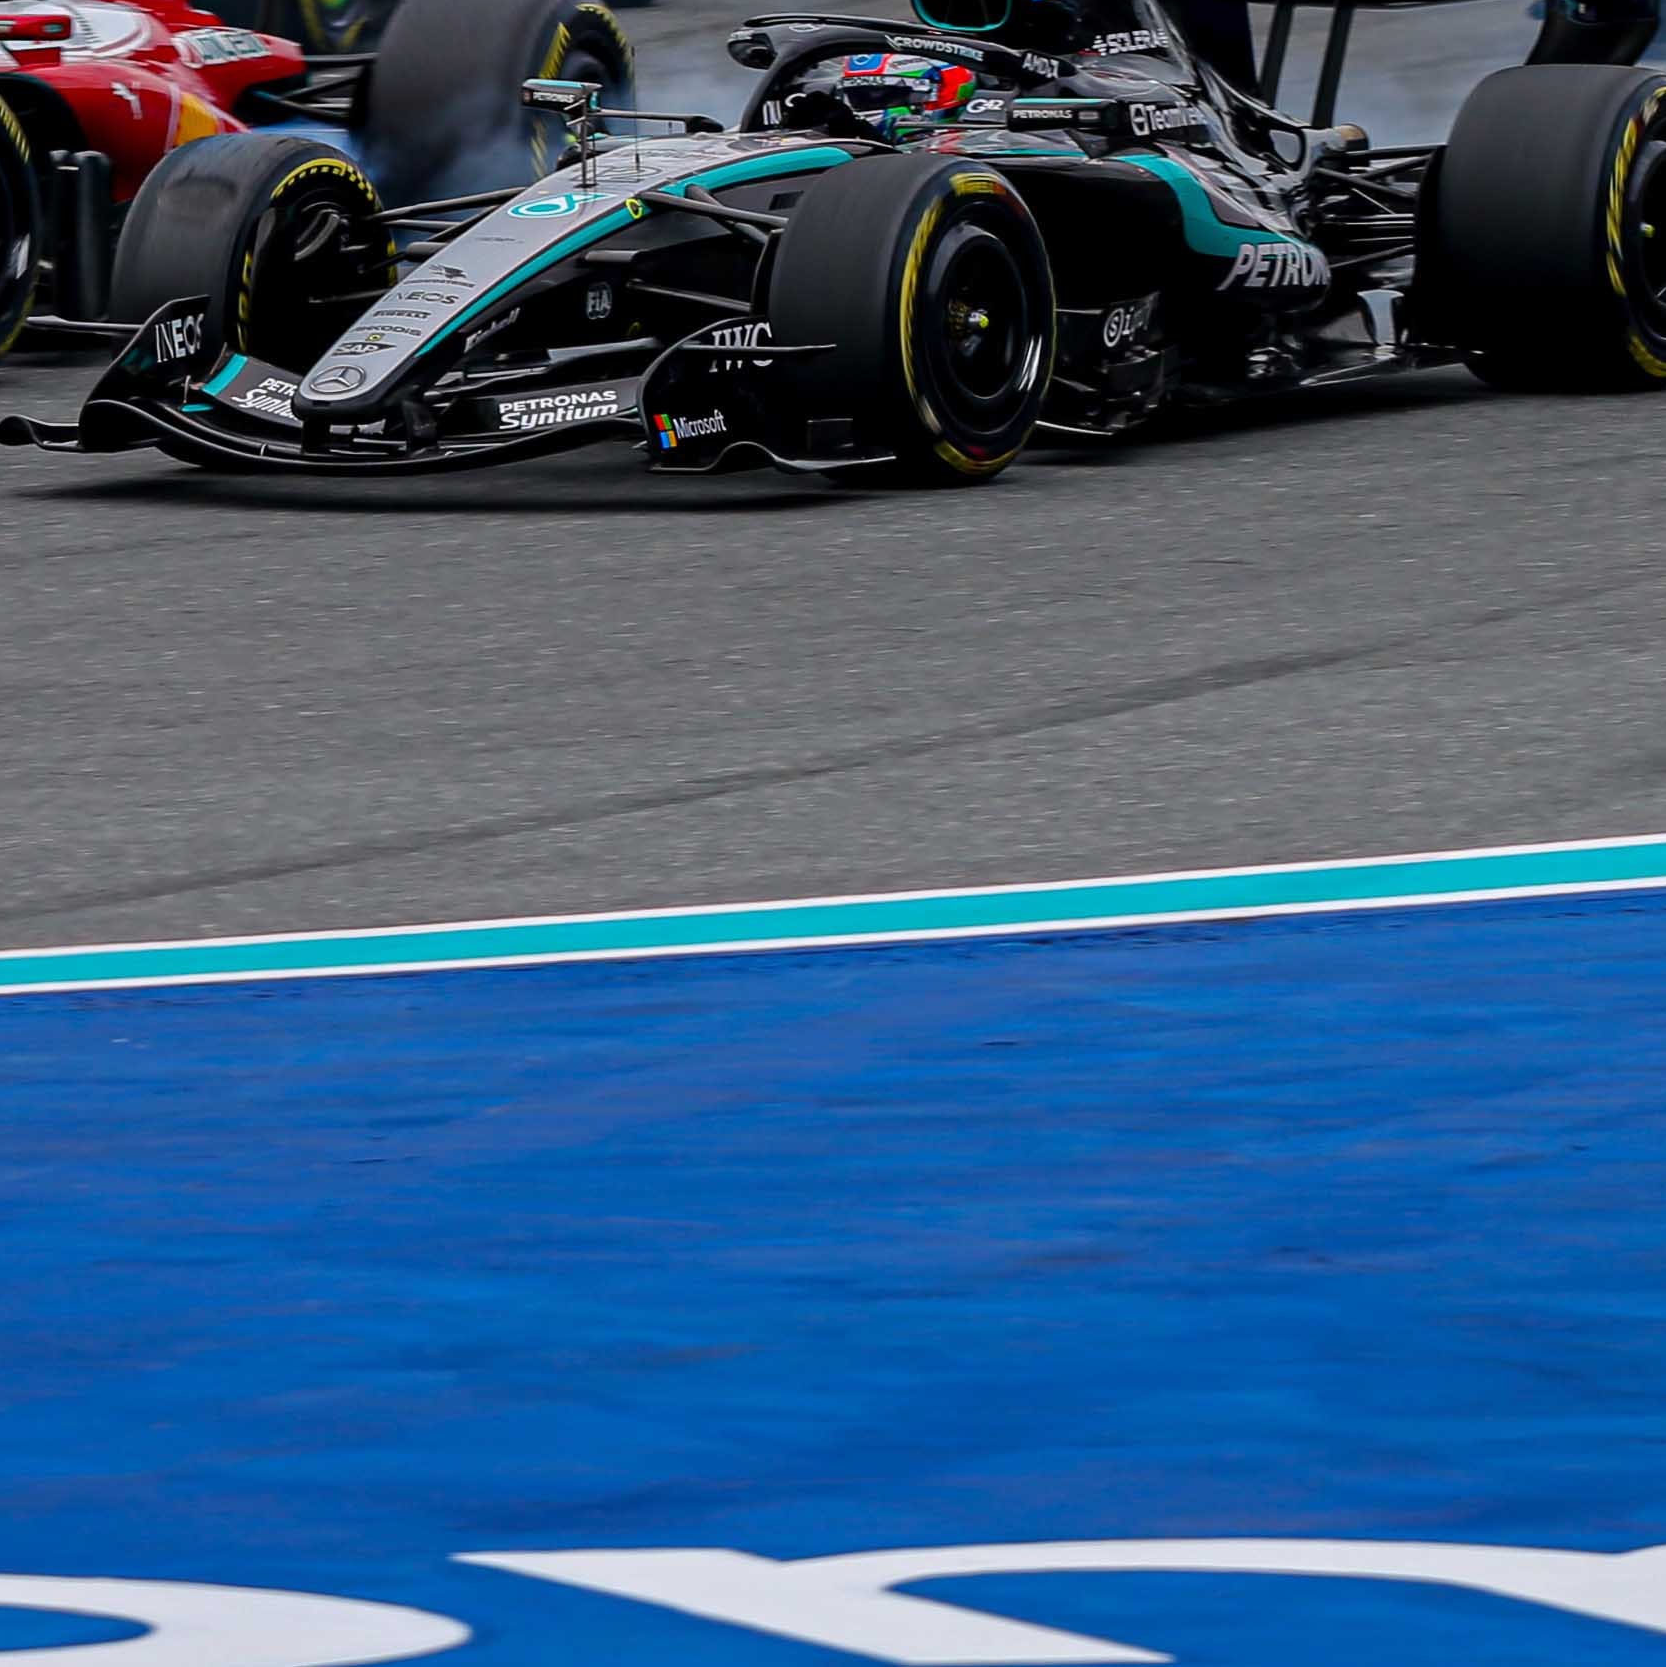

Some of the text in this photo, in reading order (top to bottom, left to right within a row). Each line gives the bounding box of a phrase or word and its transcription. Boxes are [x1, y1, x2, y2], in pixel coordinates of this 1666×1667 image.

[891, 36, 984, 62] CROWDSTRIKE
[1106, 31, 1161, 54] SOLERA
[966, 99, 1005, 114] G42
[1012, 108, 1073, 120] PETRONAS
[587, 290, 612, 312] FIA
[155, 313, 205, 363] INEOS
[337, 342, 380, 354] SAP
[708, 322, 773, 373] IWC
[498, 390, 618, 414] PETRONAS
[498, 403, 619, 430] Syntium
[673, 409, 727, 439] Microsoft
